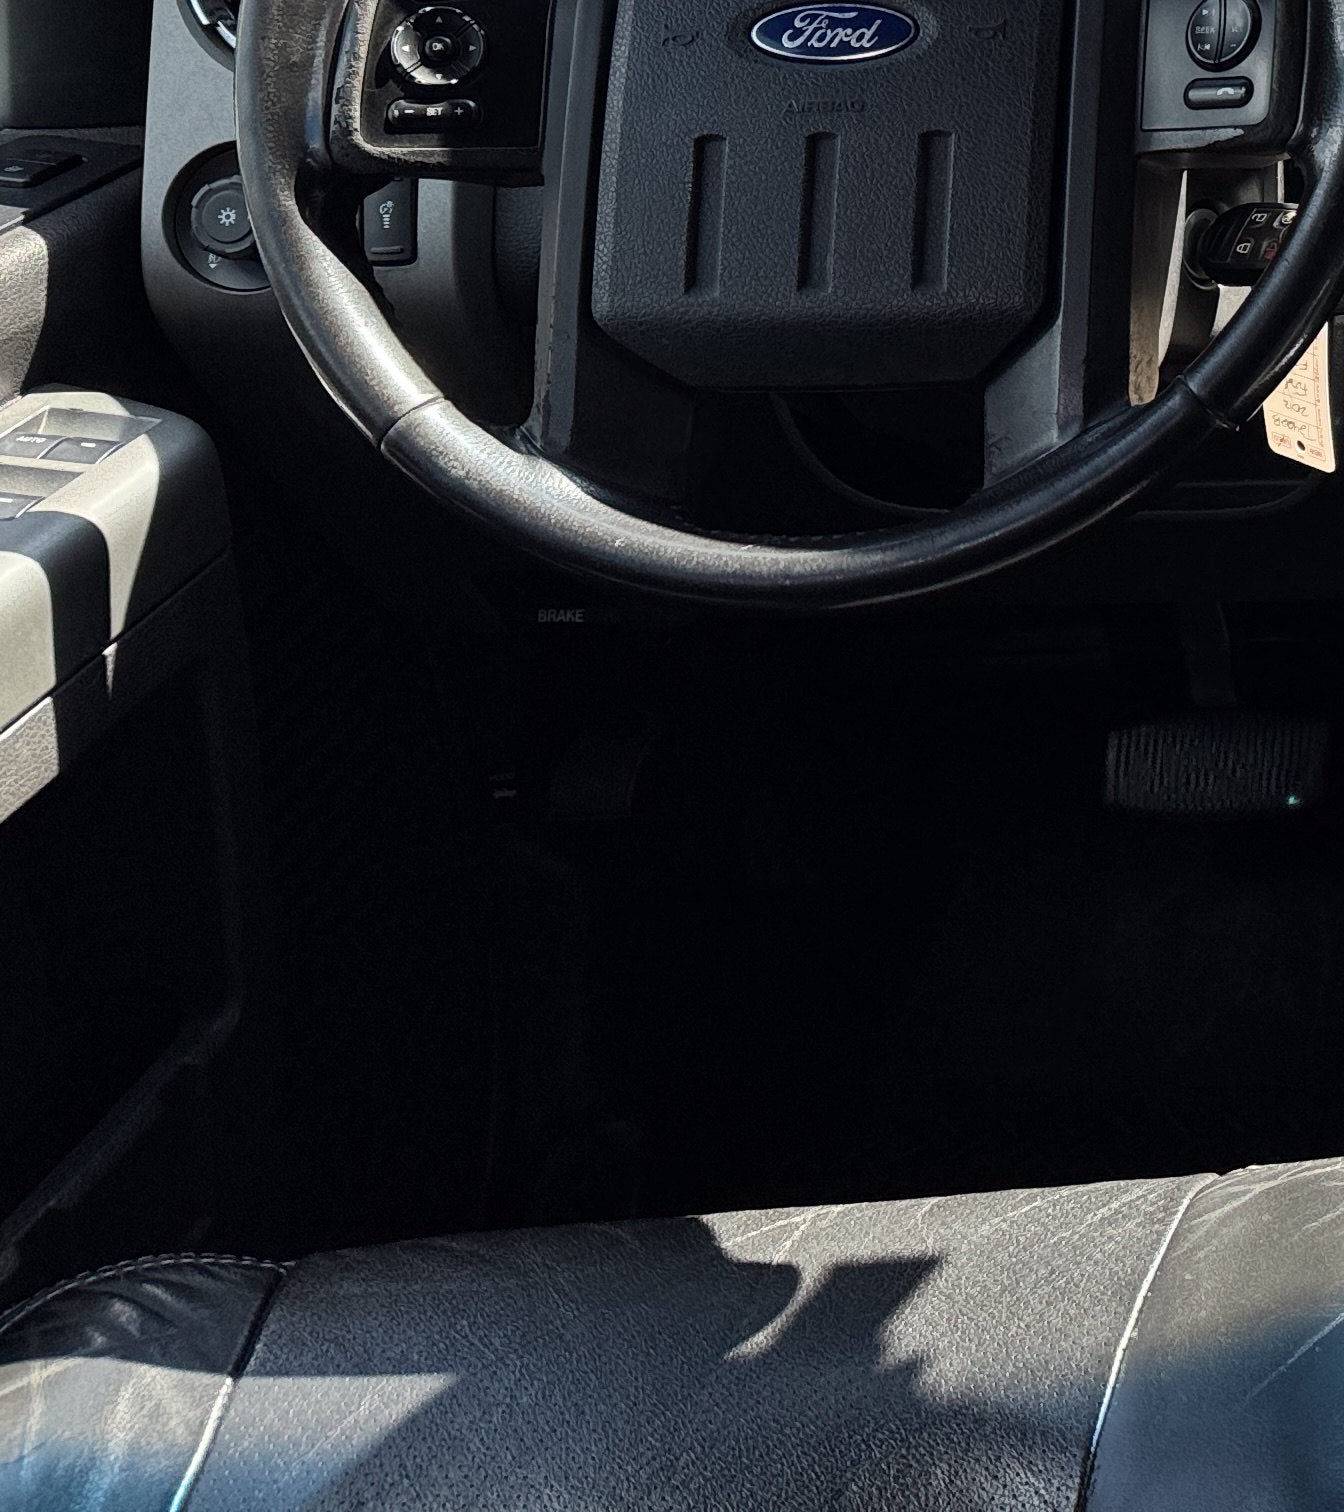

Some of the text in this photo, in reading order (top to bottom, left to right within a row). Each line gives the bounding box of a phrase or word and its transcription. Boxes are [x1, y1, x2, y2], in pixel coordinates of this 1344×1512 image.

[781, 9, 883, 49] Ford
[432, 42, 446, 51] OK
[537, 609, 586, 623] BRAKE
